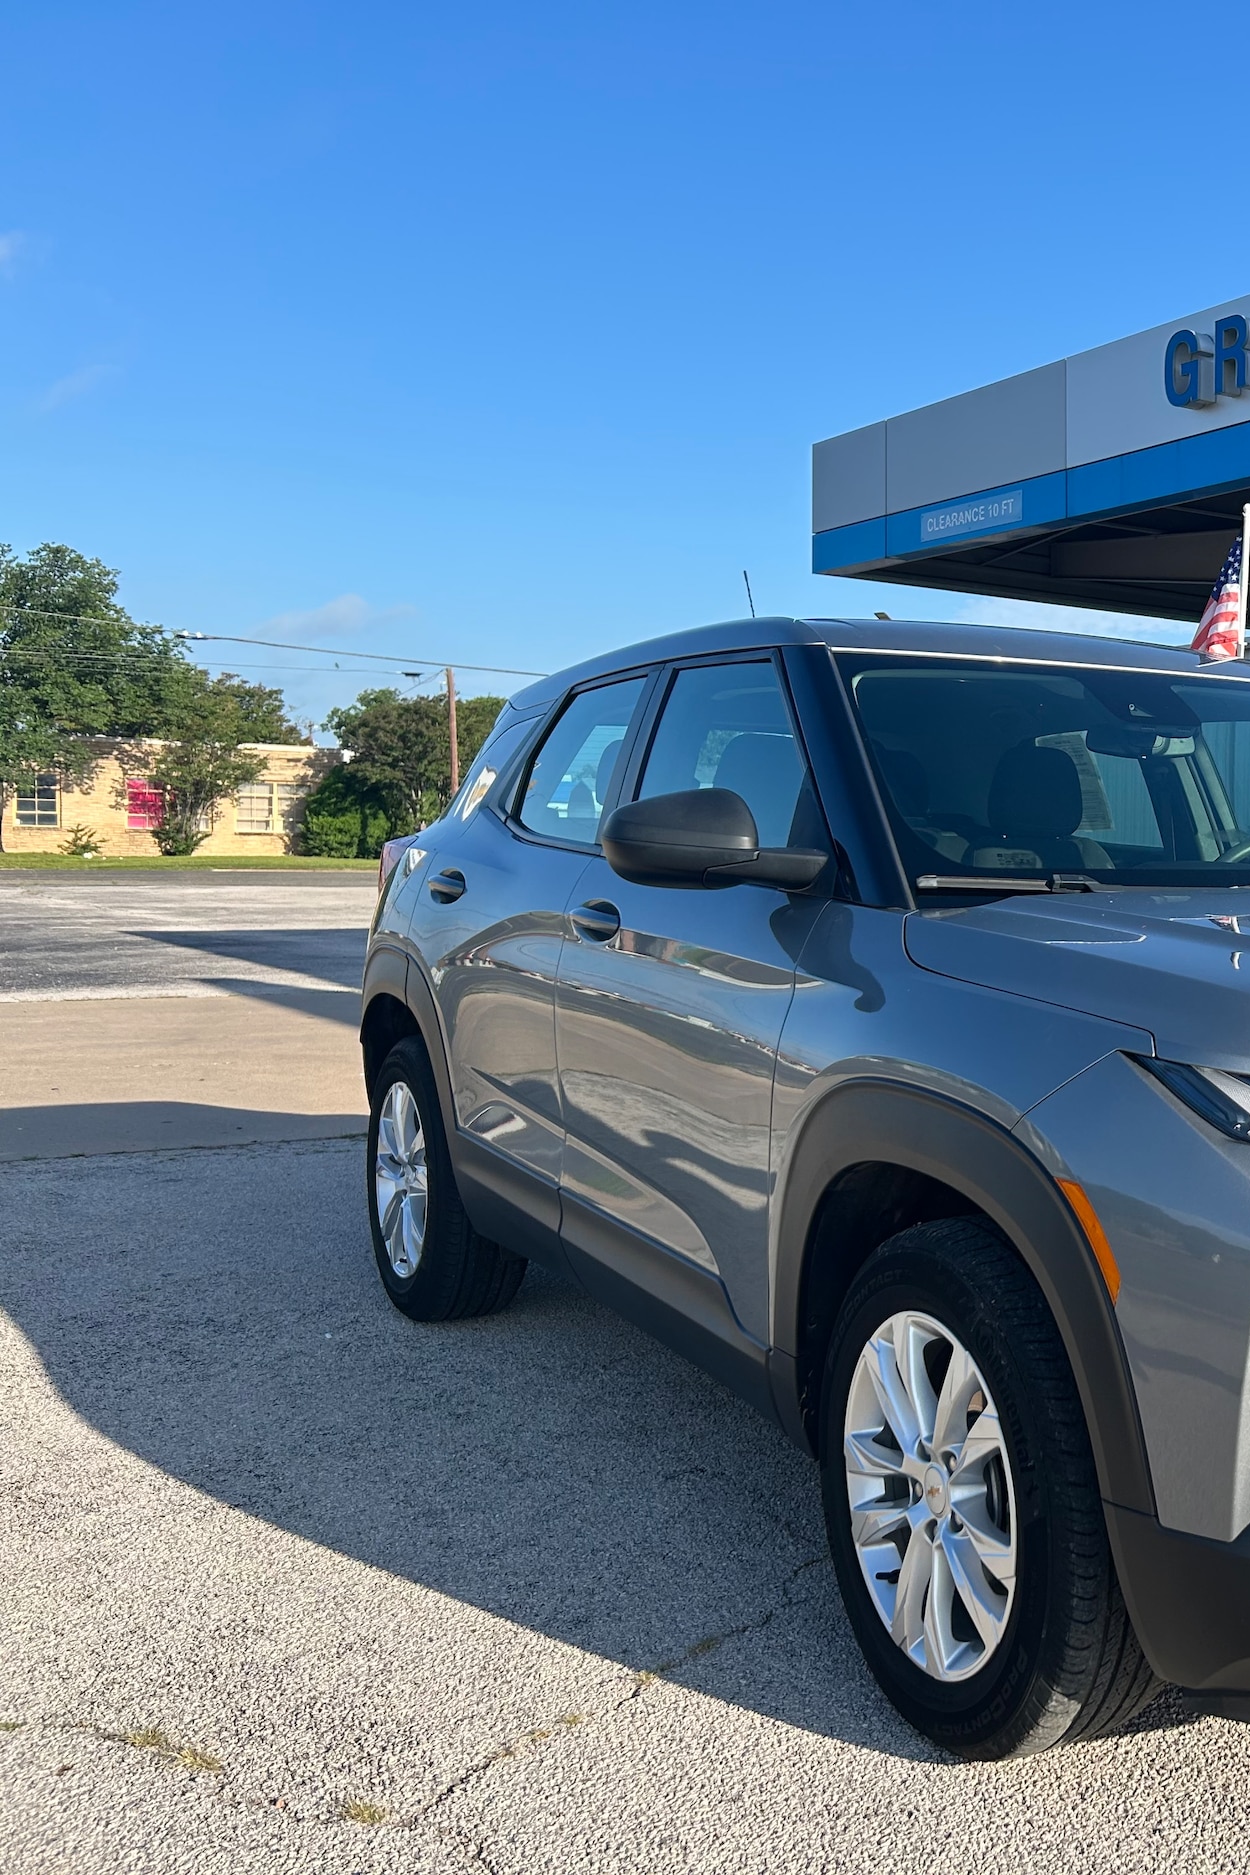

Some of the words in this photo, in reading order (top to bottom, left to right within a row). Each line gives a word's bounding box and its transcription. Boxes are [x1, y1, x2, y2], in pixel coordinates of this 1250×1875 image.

[927, 506, 985, 531] CLEARANCE
[988, 503, 999, 518] 10
[1001, 498, 1014, 516] FT
